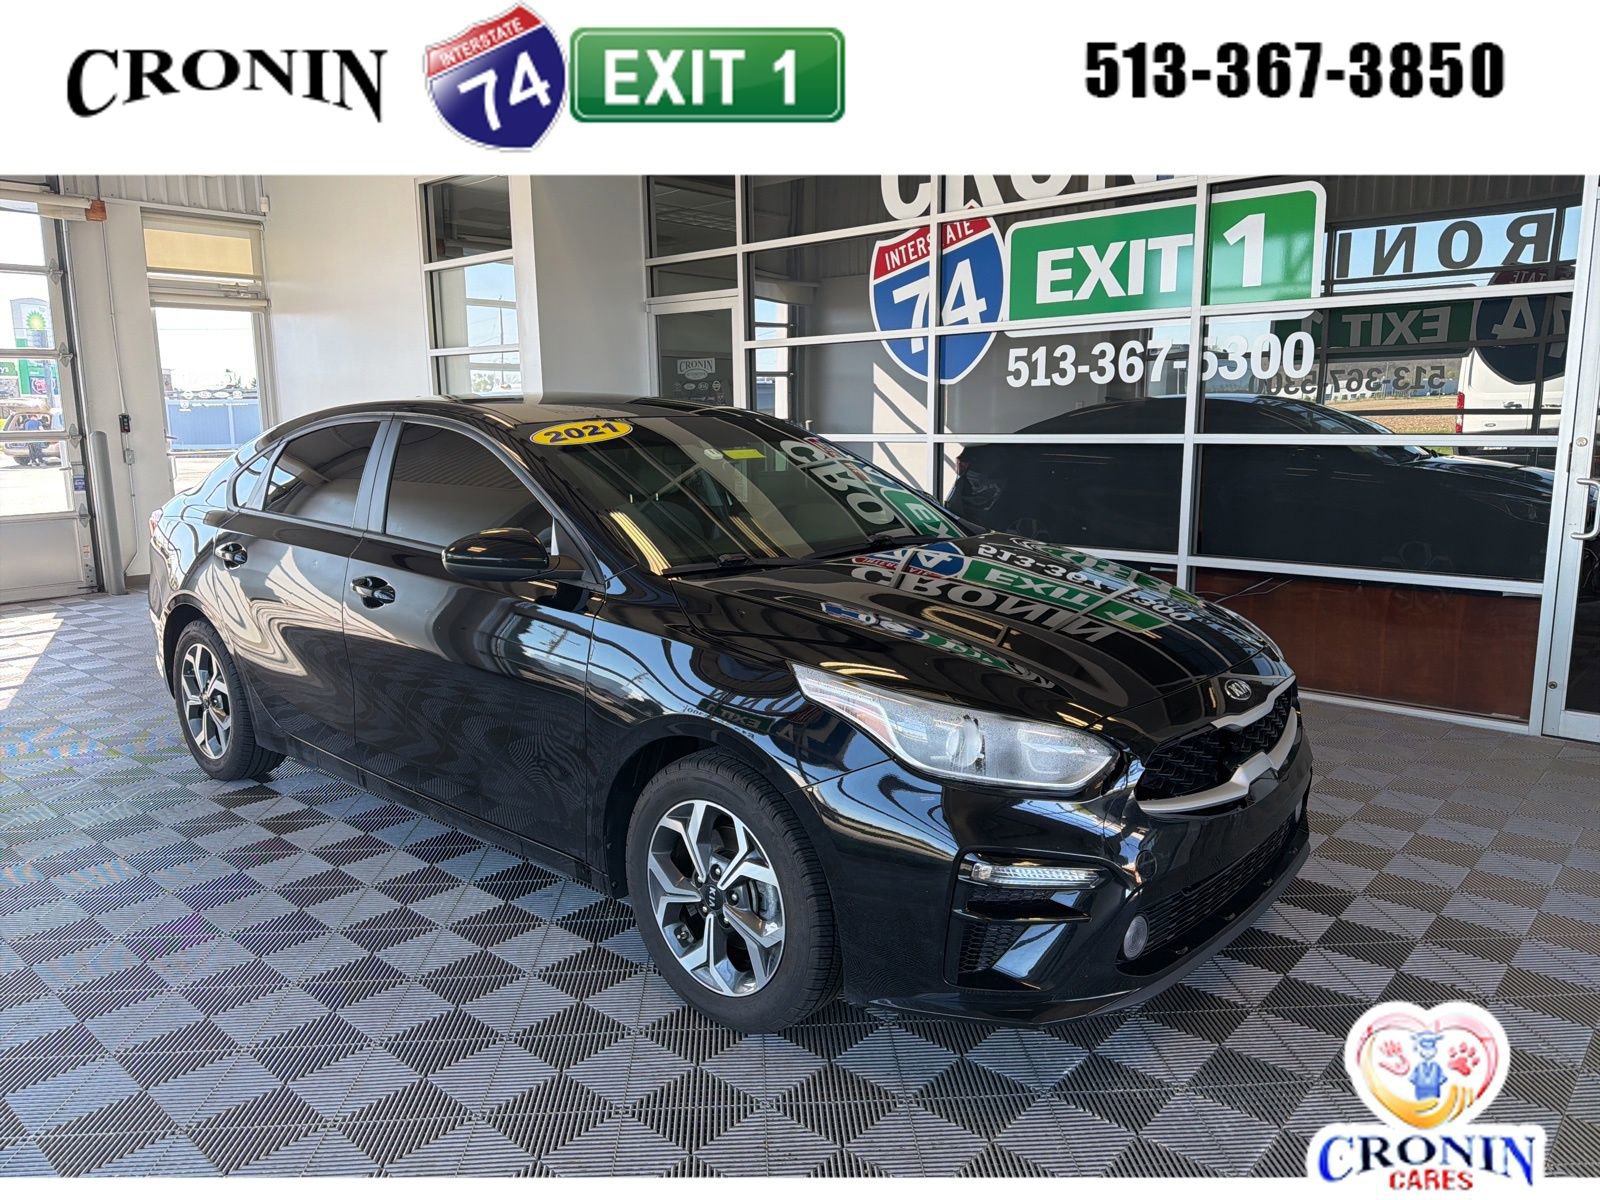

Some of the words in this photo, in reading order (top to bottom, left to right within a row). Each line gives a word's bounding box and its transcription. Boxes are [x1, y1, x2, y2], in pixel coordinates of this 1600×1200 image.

[884, 219, 974, 272] INTERSATE
[1036, 233, 1194, 305] EXIT
[1223, 213, 1266, 288] 1
[892, 258, 988, 355] 74
[679, 359, 714, 373] CRONIN
[543, 421, 618, 443] 2021
[708, 885, 717, 908] KIA
